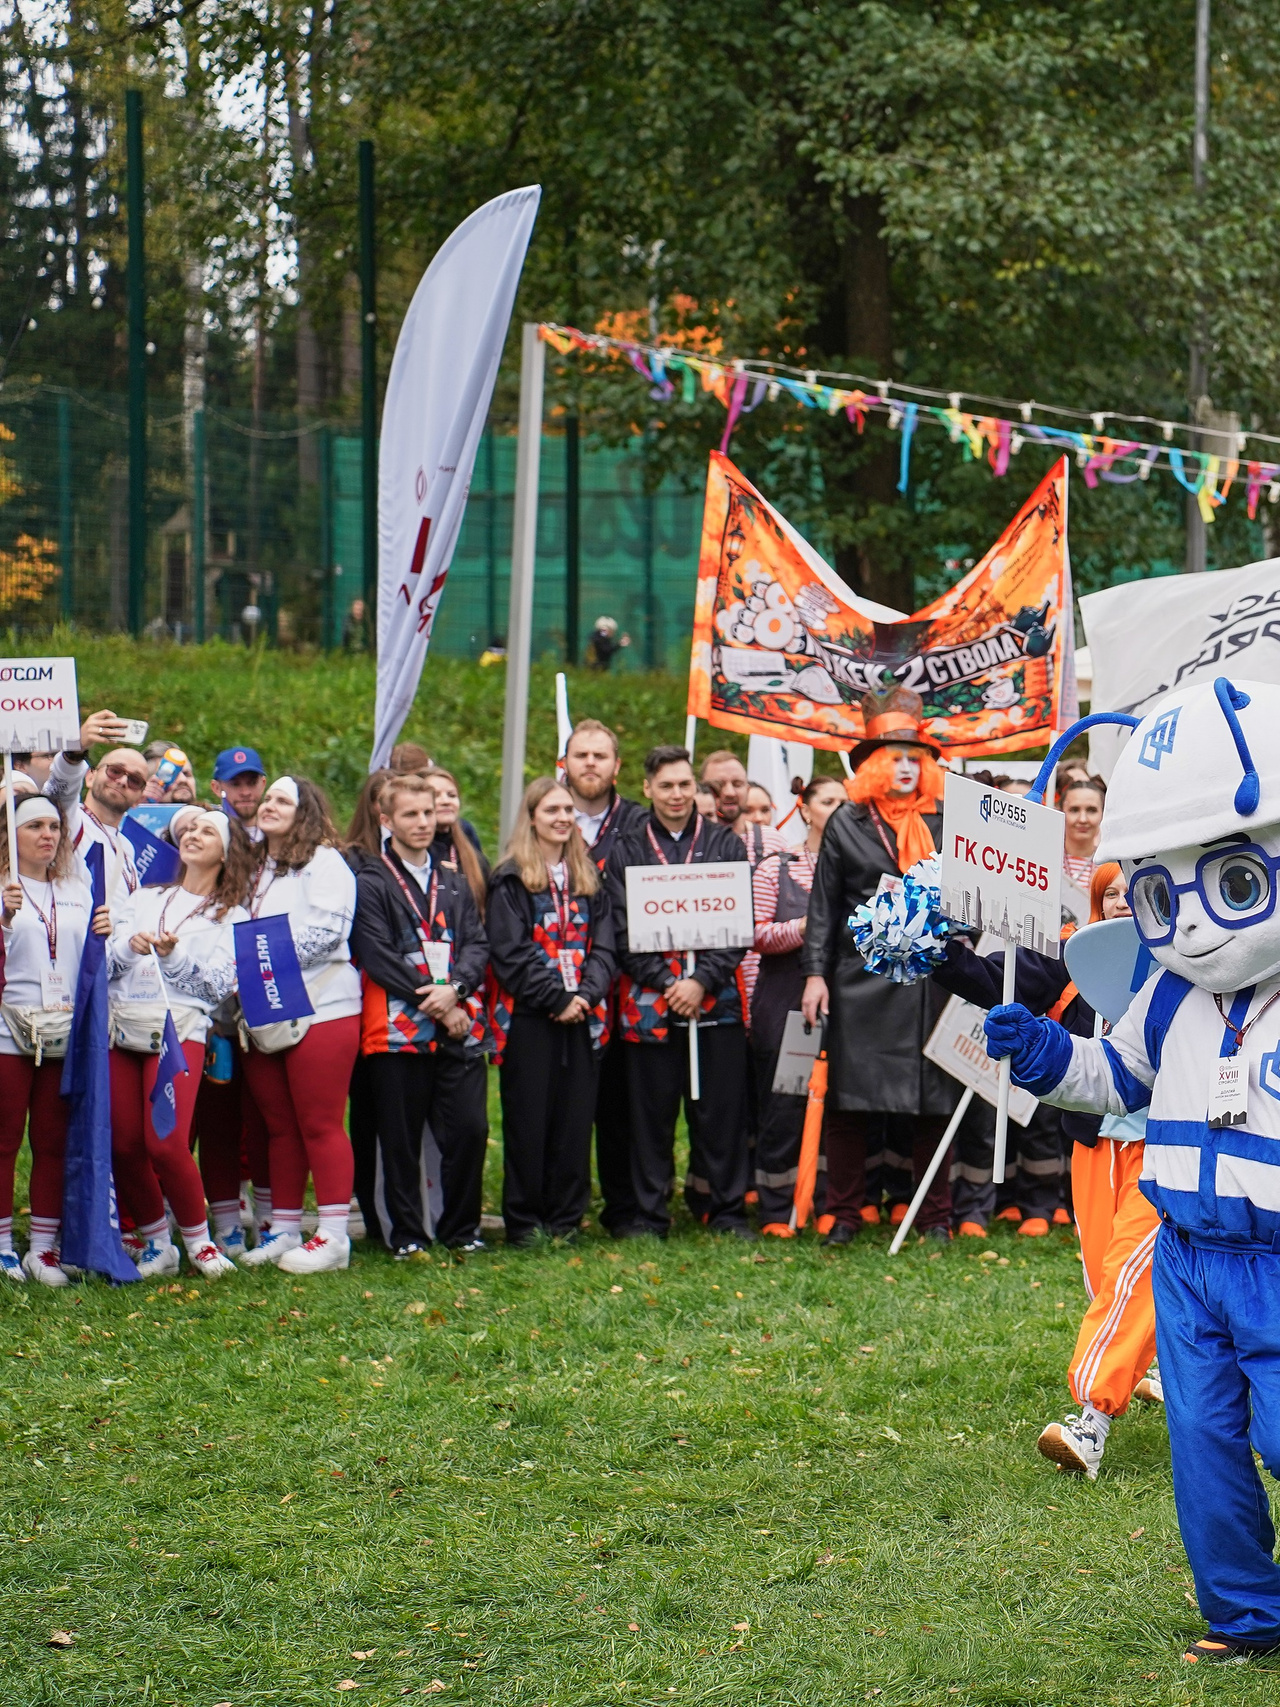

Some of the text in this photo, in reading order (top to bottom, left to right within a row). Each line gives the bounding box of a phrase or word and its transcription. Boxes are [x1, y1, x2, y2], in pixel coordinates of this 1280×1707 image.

[894, 655, 931, 694] 2
[925, 632, 1022, 685] СТВОЛА
[993, 799, 1027, 824] СУ555
[954, 834, 1049, 892] ГК СУ-555
[644, 897, 736, 915] ОСК 1520
[953, 1034, 990, 1071] ПИТЬ
[1219, 1070, 1238, 1080] XVIII
